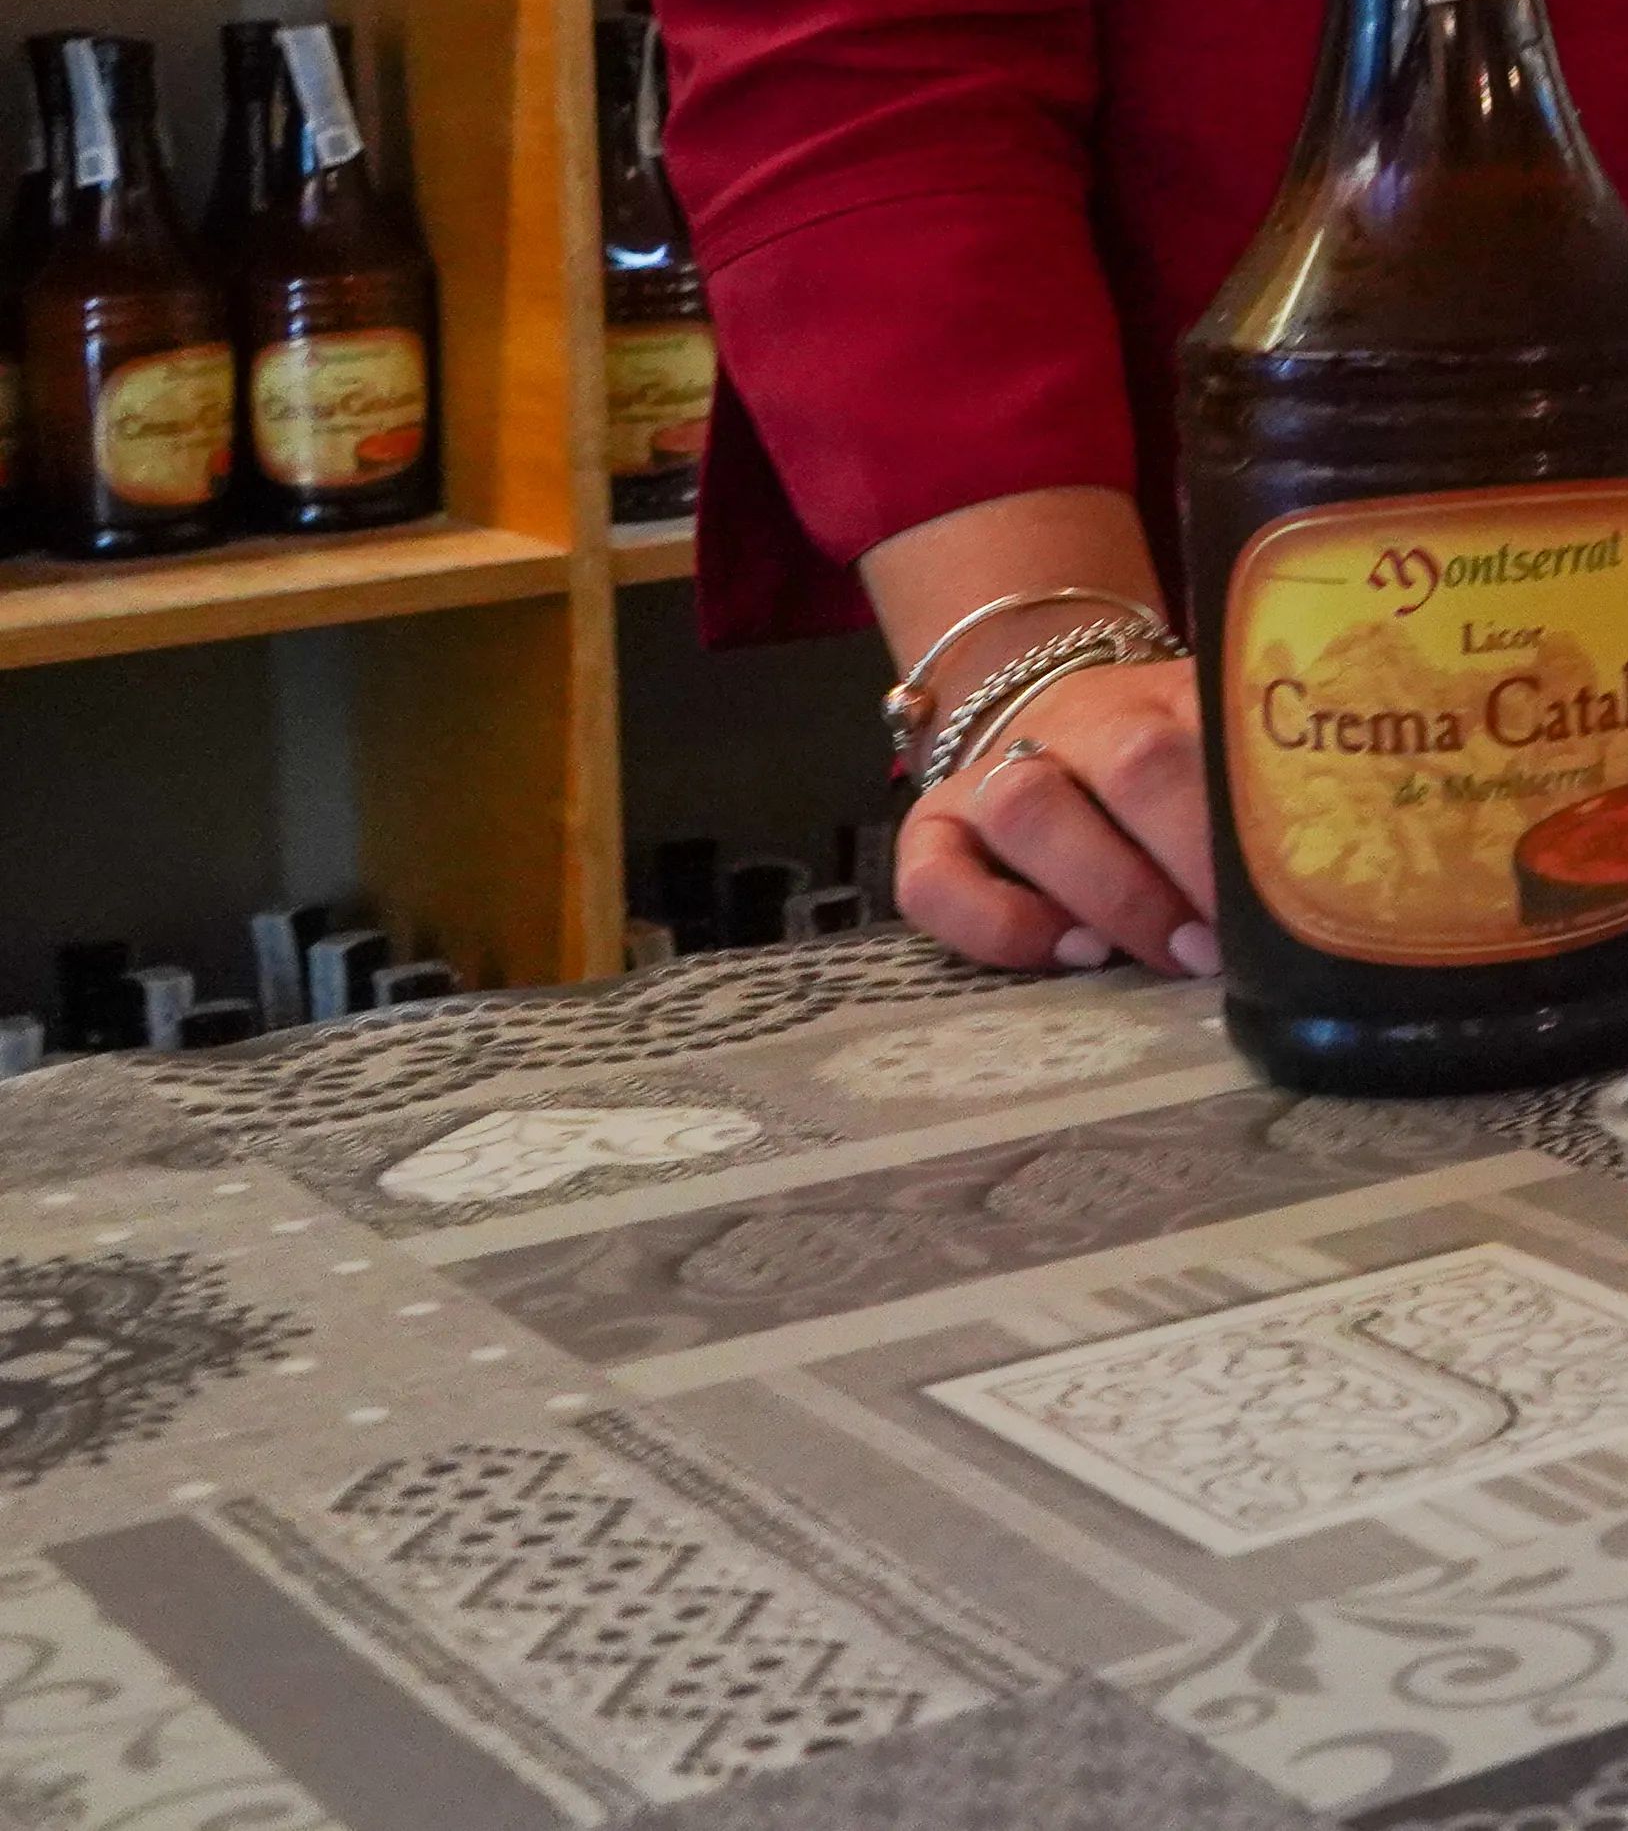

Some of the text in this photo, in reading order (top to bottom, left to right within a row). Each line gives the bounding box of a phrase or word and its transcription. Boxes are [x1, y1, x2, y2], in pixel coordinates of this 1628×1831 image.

[1366, 529, 1623, 618] Montserrat
[1459, 620, 1546, 656] Licor
[1261, 677, 1466, 756] Crema
